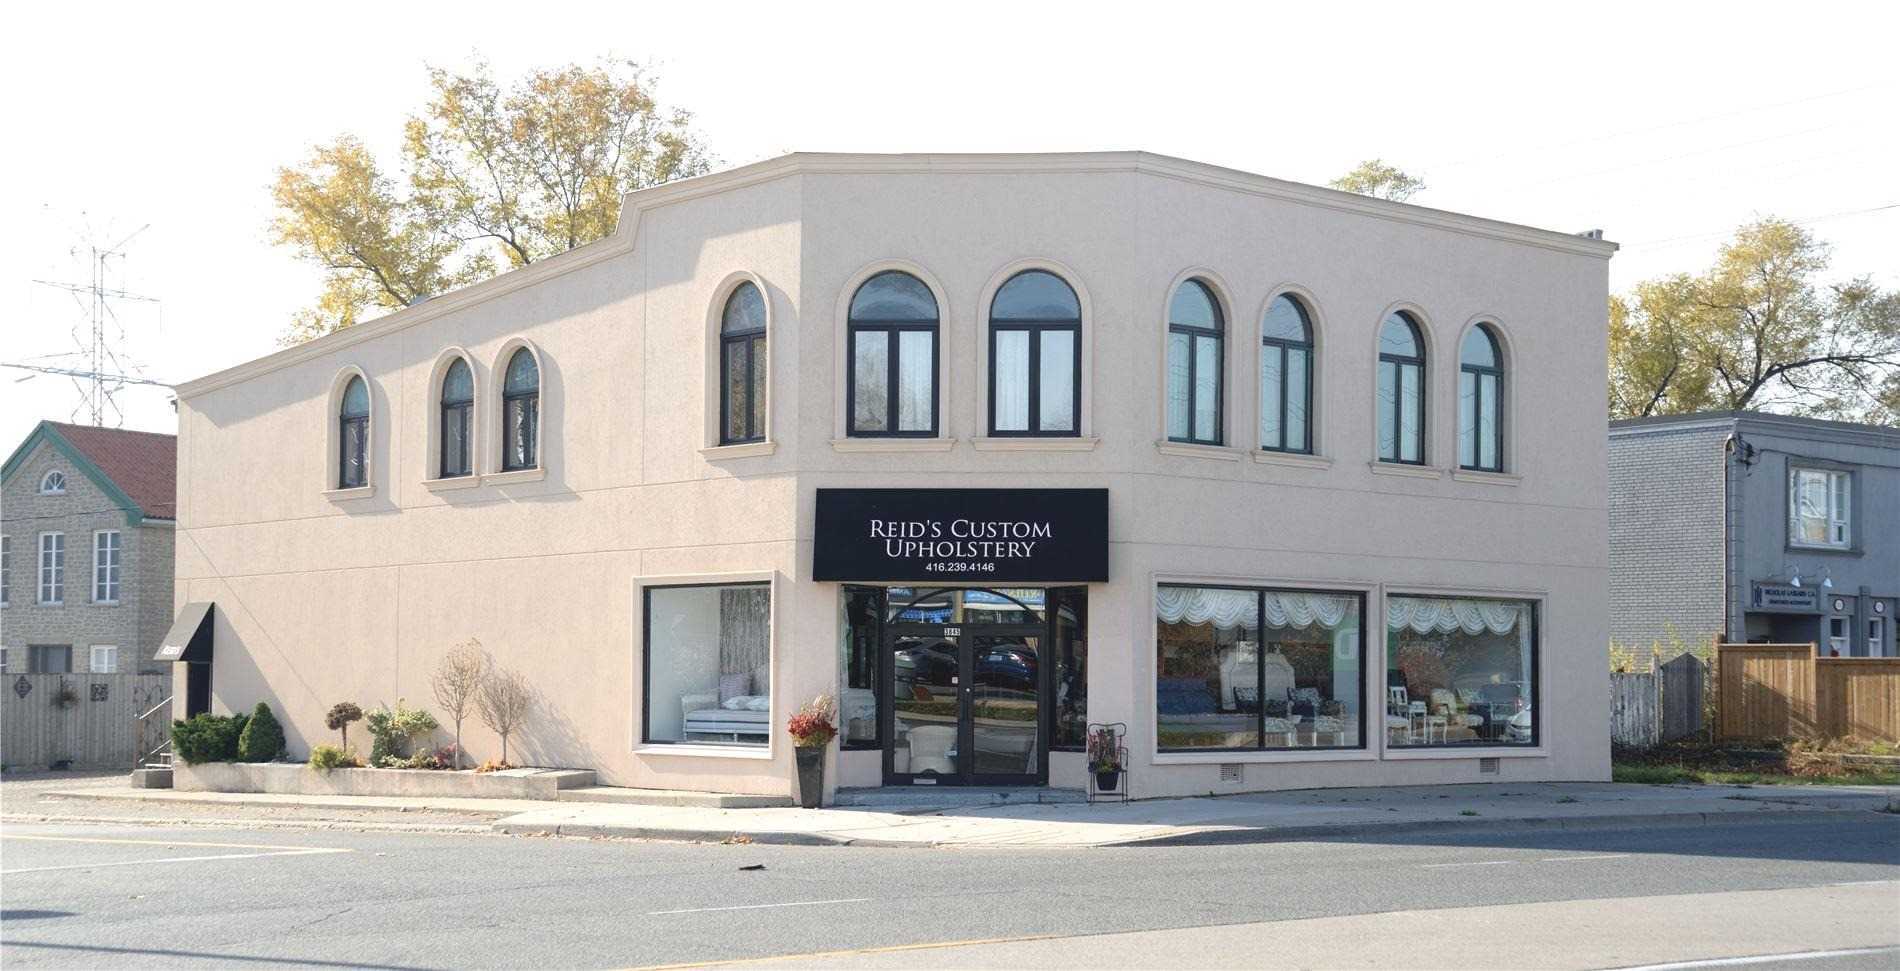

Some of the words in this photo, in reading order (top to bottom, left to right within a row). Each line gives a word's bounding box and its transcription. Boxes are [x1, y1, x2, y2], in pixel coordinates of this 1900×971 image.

[869, 519, 942, 538] REID'S
[951, 519, 1052, 538] CUSTOM
[885, 539, 1036, 558] UPHOLSTERY
[925, 562, 995, 572] 416.239.4146
